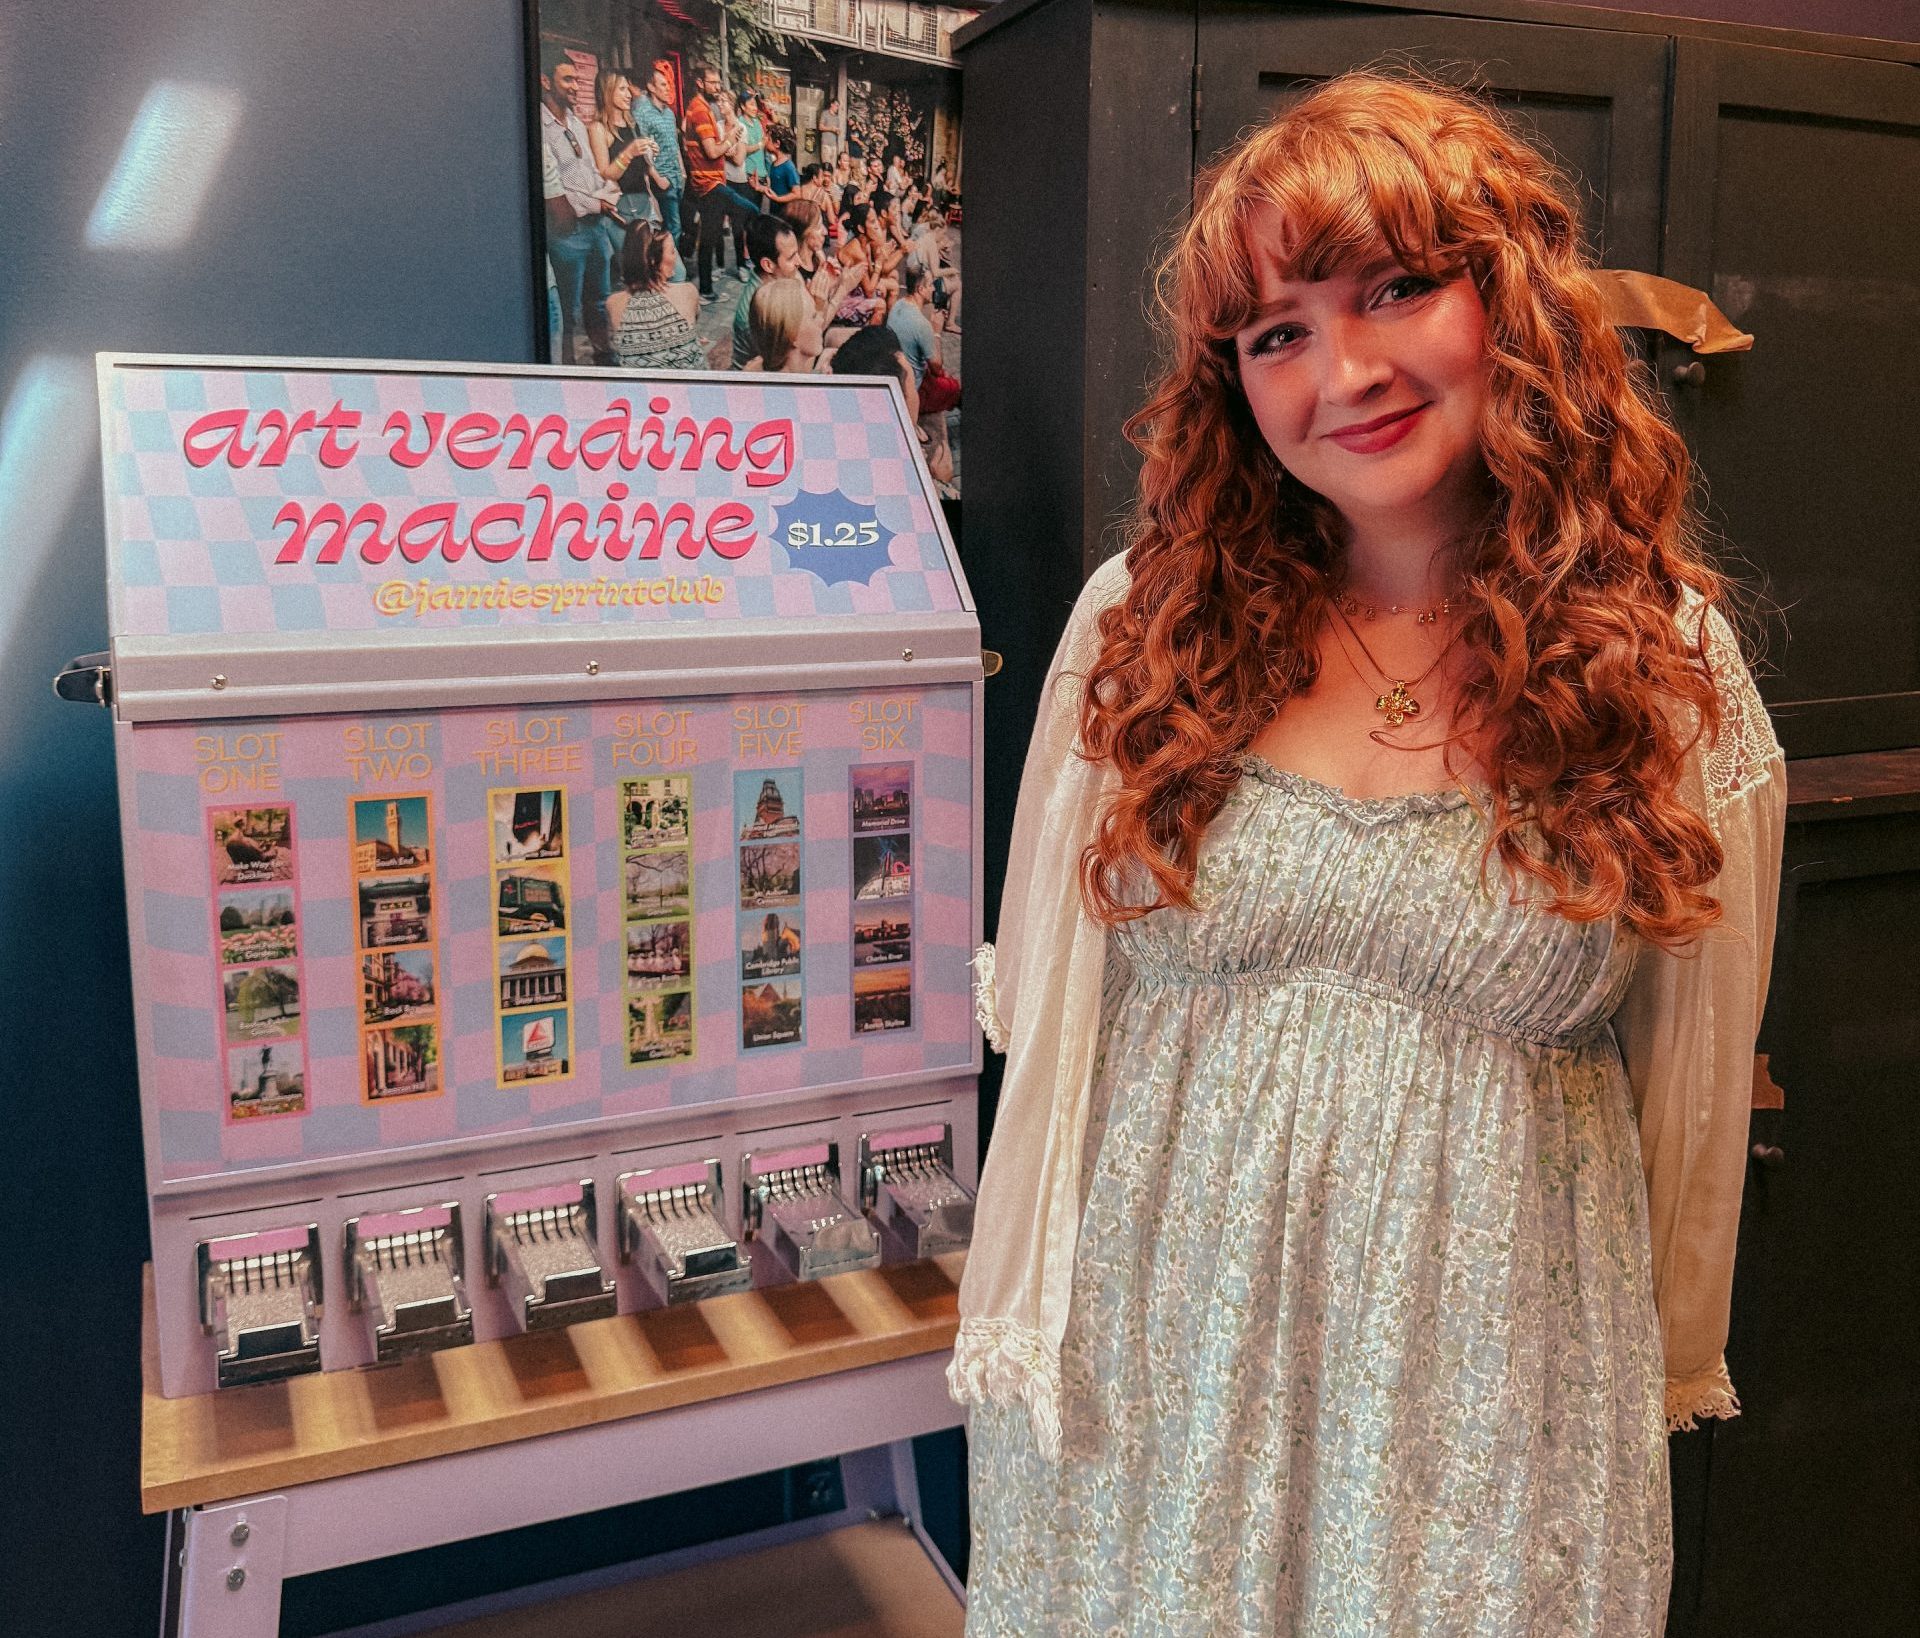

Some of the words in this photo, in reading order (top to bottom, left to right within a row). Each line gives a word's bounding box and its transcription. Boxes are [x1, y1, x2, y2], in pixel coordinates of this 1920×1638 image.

[184, 399, 362, 469] art
[382, 398, 794, 487] vending
[273, 483, 758, 564] machine
[788, 519, 880, 549] $1.25
[374, 575, 726, 617] @jamiesprintclub
[614, 710, 693, 738] SLOT
[732, 703, 808, 731] SLOT
[849, 699, 919, 725] SLOT
[343, 723, 432, 753] SLOT
[485, 716, 568, 747] SLOT
[739, 731, 805, 759] FIVE
[862, 725, 906, 751] SIX
[193, 733, 284, 764] SLOT
[472, 745, 582, 776] THREE
[612, 738, 699, 768] FOUR
[201, 762, 281, 793] ONE
[344, 752, 432, 784] TWO
[250, 860, 270, 870] Way
[745, 959, 780, 970] Cambridge
[761, 968, 784, 976] Library
